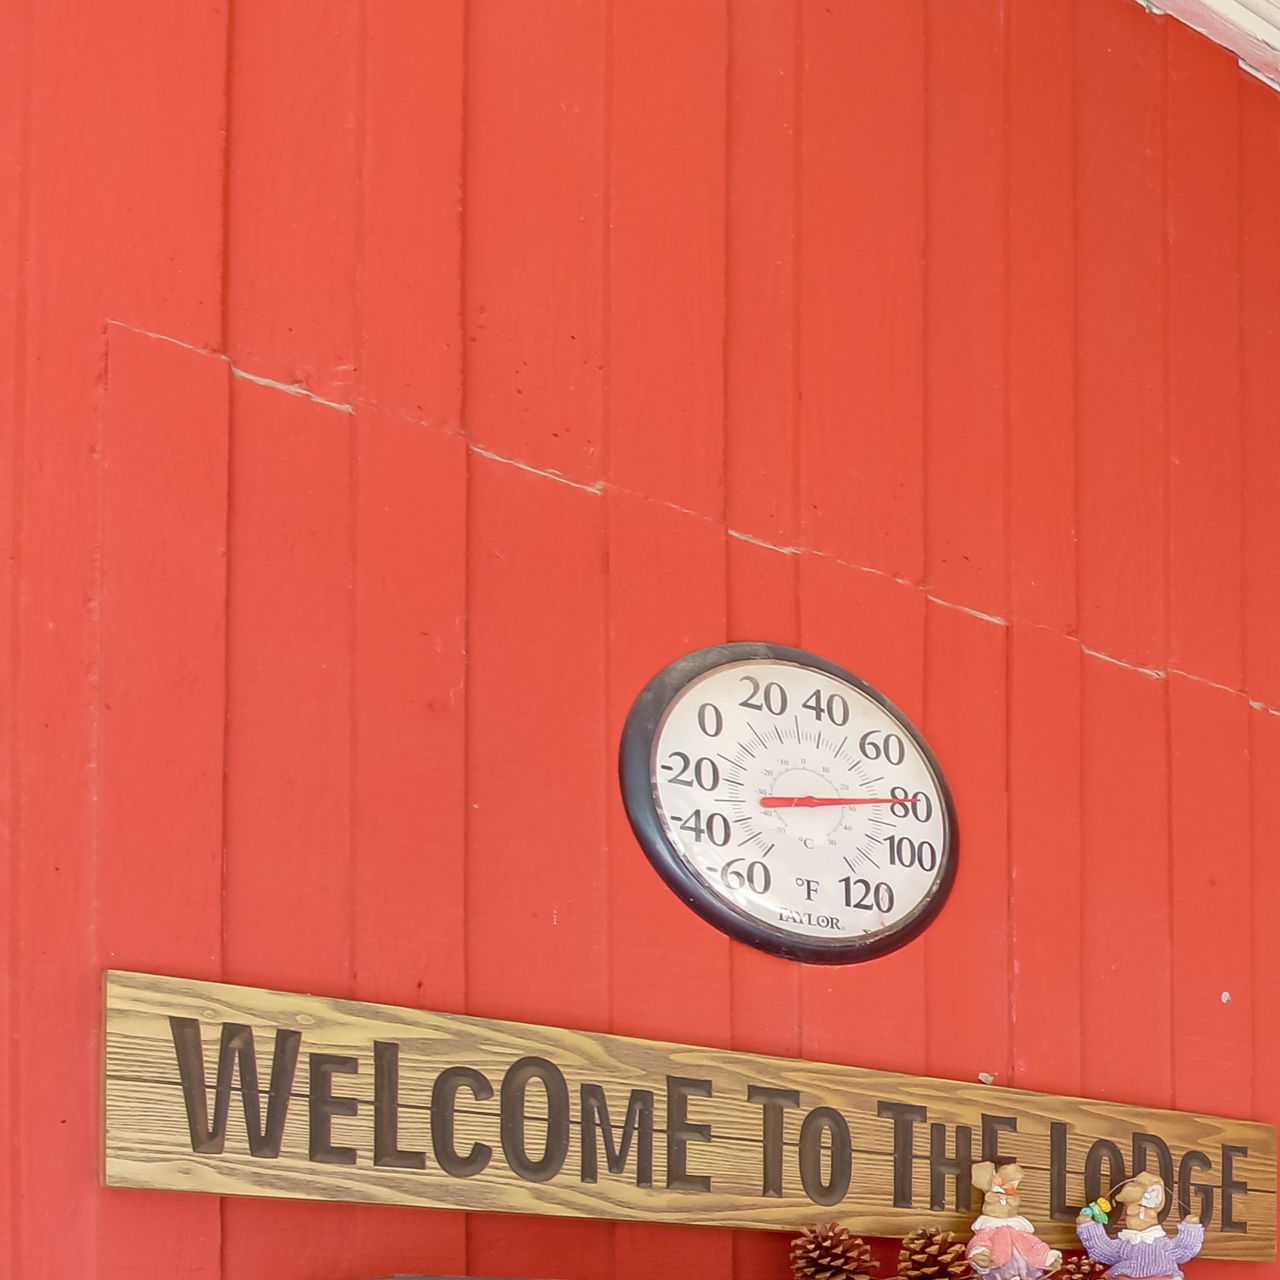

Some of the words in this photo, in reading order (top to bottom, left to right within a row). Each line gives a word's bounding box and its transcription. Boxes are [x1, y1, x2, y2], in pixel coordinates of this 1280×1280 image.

[739, 675, 788, 716] 20
[802, 688, 850, 727] 40
[698, 702, 723, 738] 0
[859, 730, 905, 766] 60
[661, 751, 720, 792] -20
[889, 786, 933, 823] 80
[670, 809, 731, 847] -40
[884, 834, 937, 872] 100
[838, 876, 894, 914] 120
[169, 1015, 712, 1193] WELCOME
[747, 1084, 852, 1207] TO
[1050, 1121, 1248, 1234] LODGE
